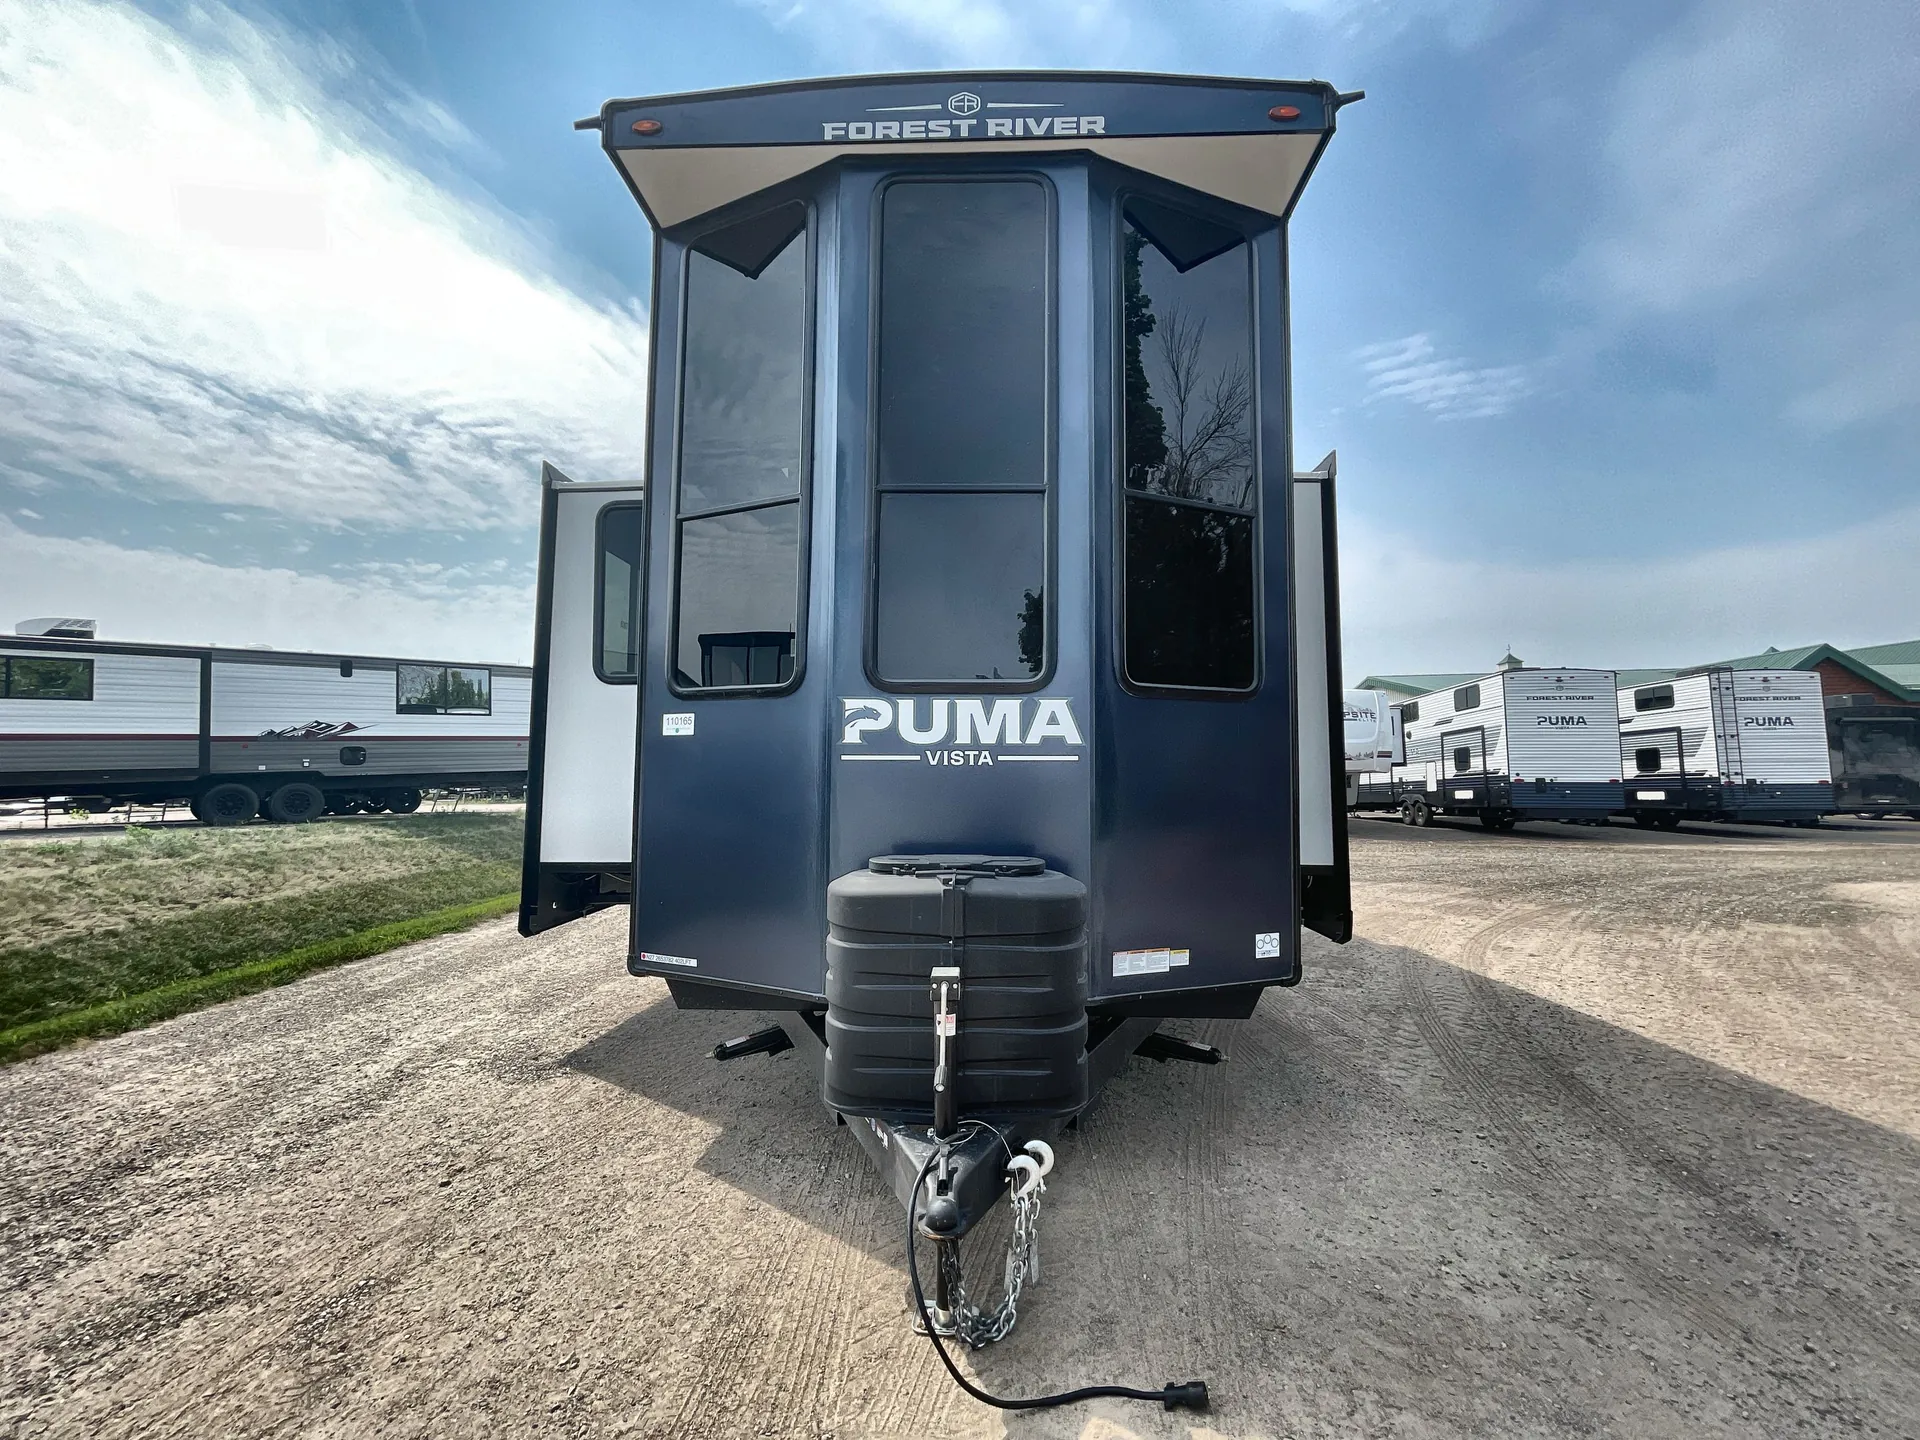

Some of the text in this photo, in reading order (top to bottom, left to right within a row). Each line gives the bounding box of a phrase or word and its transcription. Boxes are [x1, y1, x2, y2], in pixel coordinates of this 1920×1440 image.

[822, 115, 1106, 141] FOREST RIVER
[666, 716, 693, 726] 110165
[840, 697, 1084, 745] PUMA
[1536, 715, 1588, 726] PUMA
[1743, 716, 1794, 727] PUMA
[925, 750, 994, 767] VISTA
